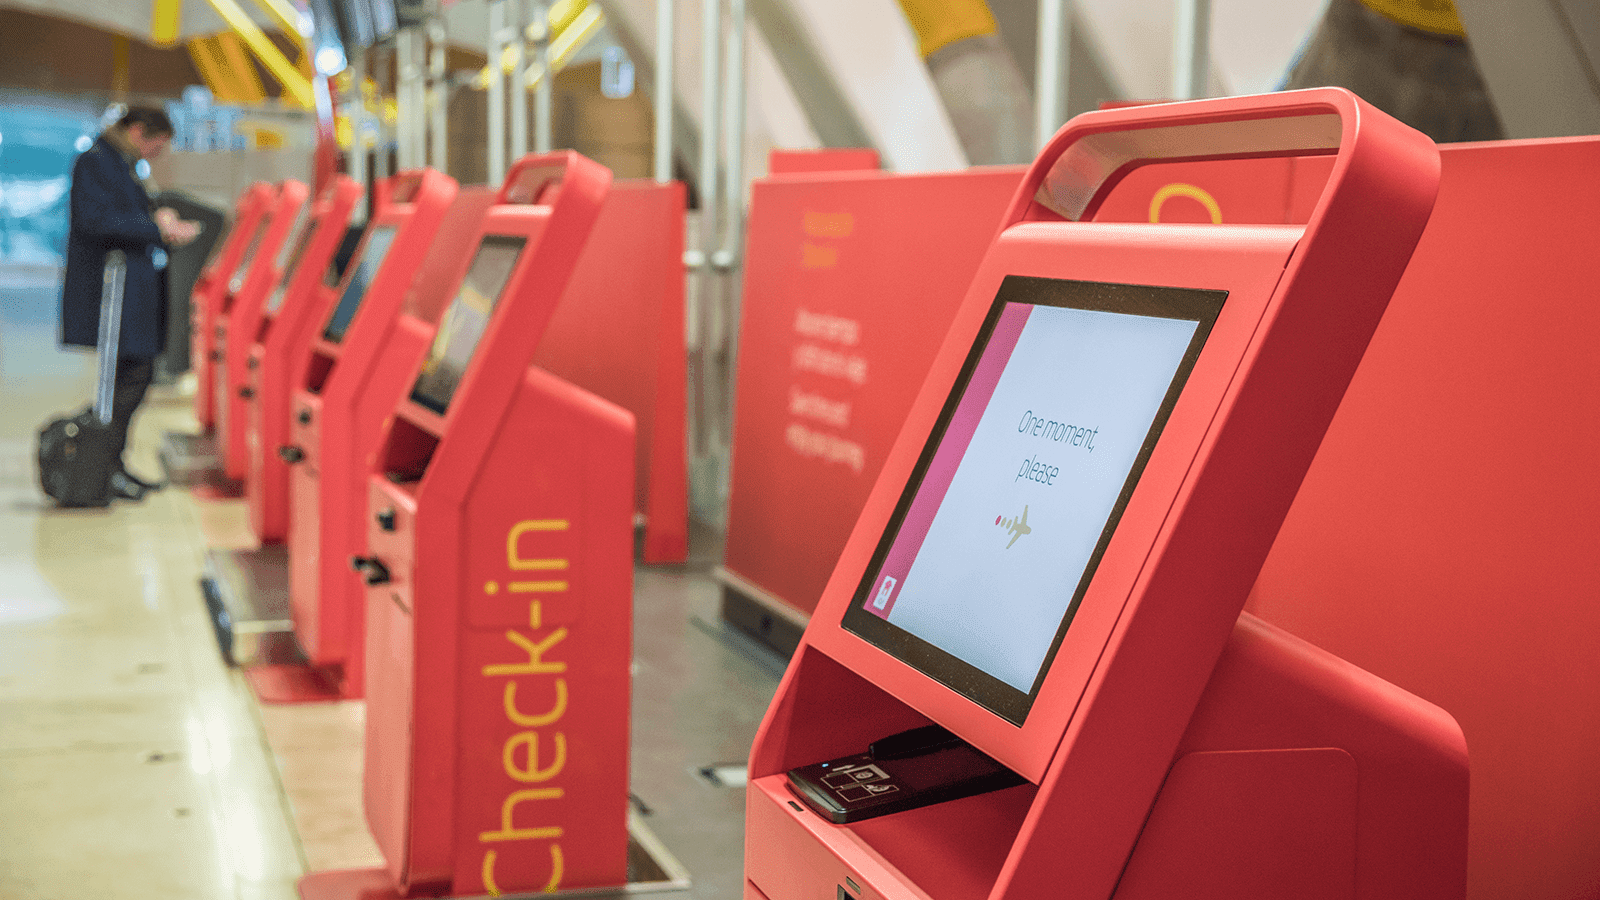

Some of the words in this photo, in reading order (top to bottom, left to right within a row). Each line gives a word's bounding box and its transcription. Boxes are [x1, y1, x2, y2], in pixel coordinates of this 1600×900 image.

[1018, 410, 1044, 437] One
[1041, 420, 1099, 453] moment,
[1015, 454, 1059, 485] please
[478, 519, 569, 897] Check-in
